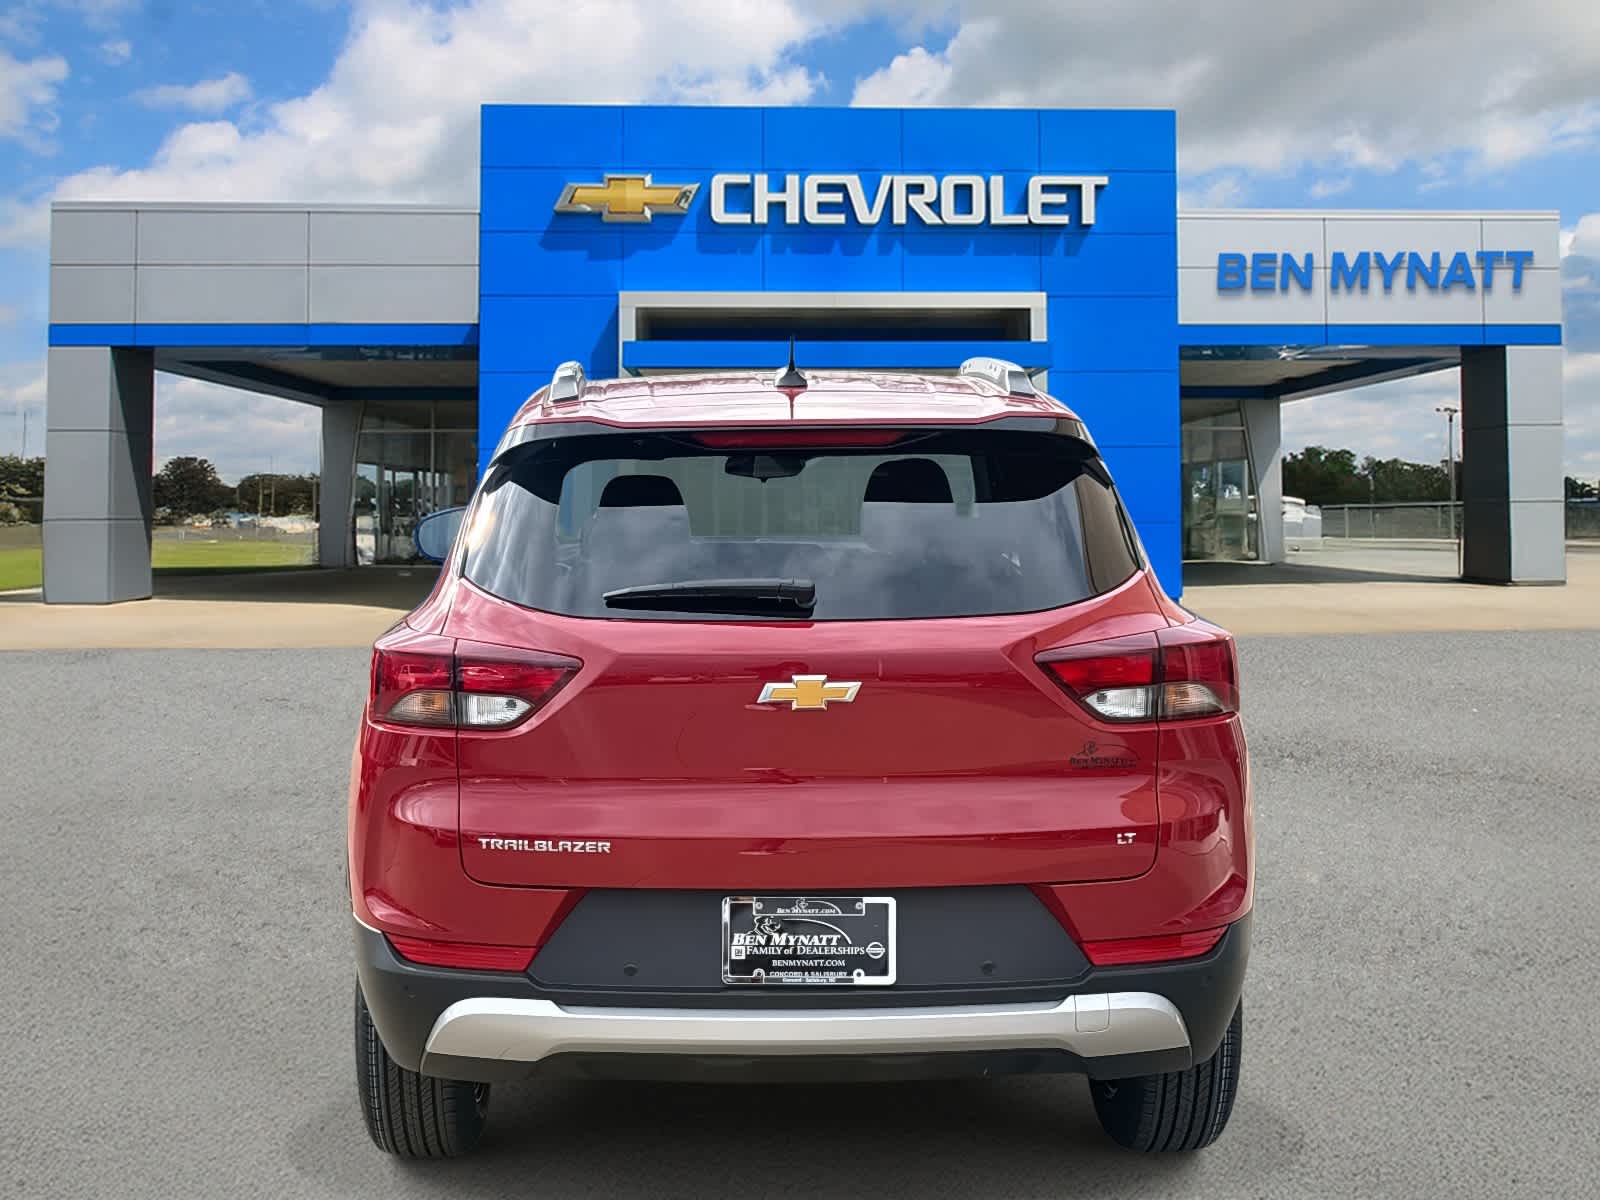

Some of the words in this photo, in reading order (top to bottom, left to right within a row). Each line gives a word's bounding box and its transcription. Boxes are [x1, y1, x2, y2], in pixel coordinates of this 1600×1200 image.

[710, 173, 1109, 225] CHEVROLET
[1217, 252, 1314, 291] BEN
[1330, 250, 1534, 290] MYNATT
[478, 838, 611, 853] TRAILBLAZER
[1117, 833, 1137, 845] LT
[732, 933, 767, 945] BEN
[771, 932, 841, 945] MYNATT
[746, 945, 783, 955] FAMILY
[783, 946, 794, 955] of
[796, 945, 865, 955] DEALERSHIPS
[772, 959, 846, 967] BENMYNATT.COM
